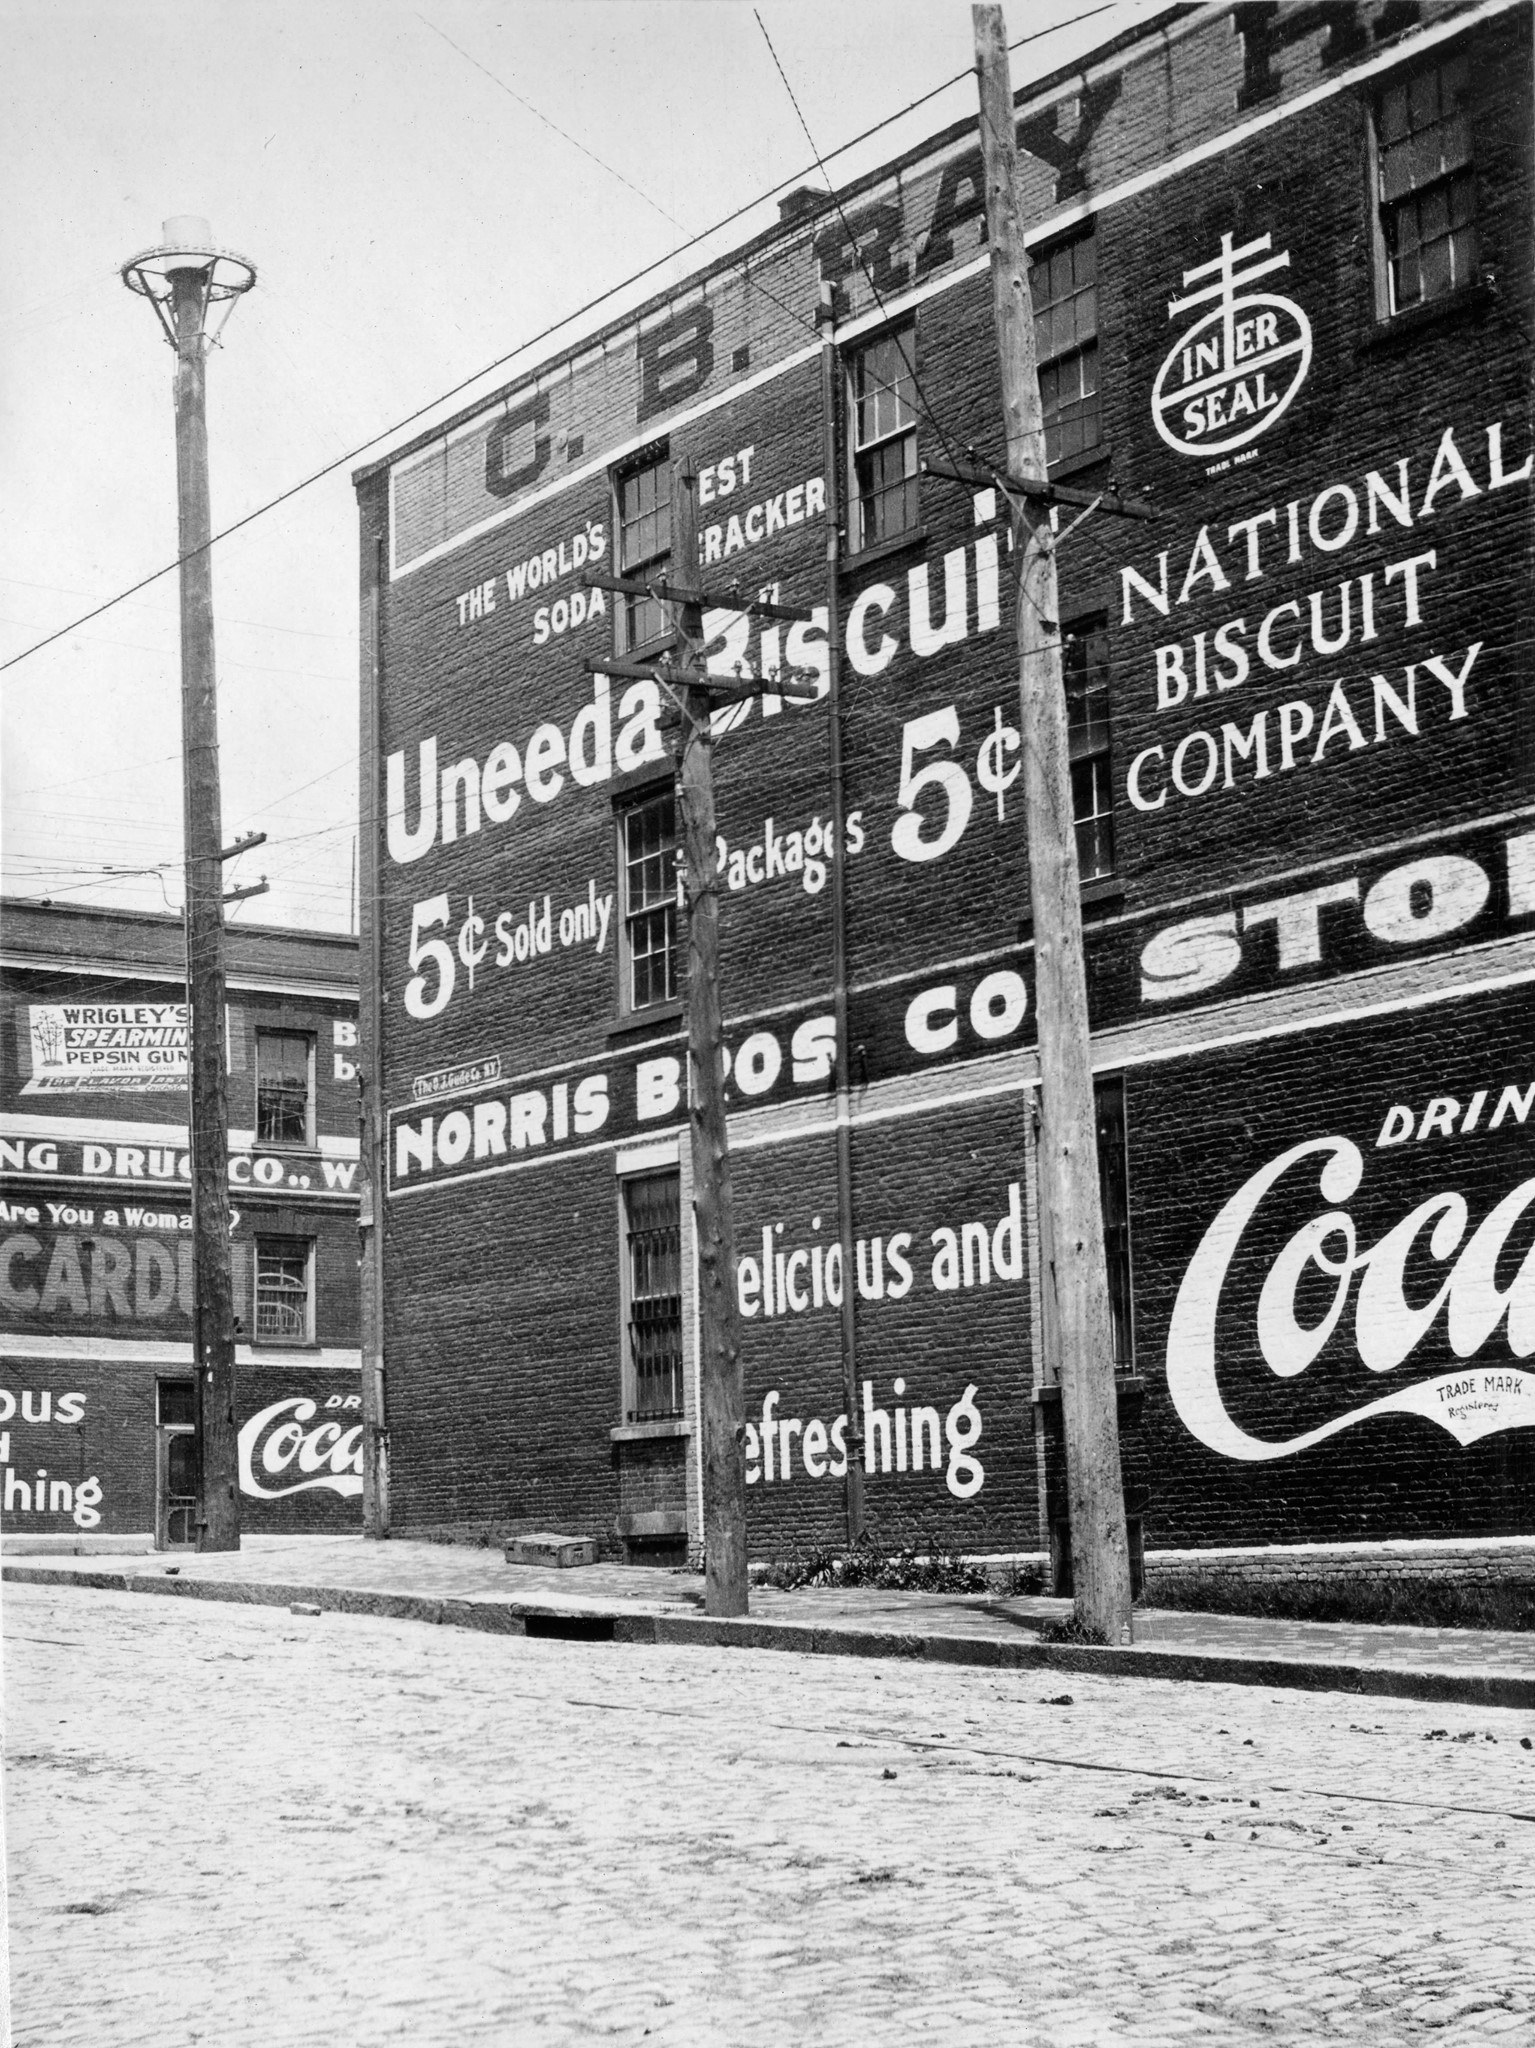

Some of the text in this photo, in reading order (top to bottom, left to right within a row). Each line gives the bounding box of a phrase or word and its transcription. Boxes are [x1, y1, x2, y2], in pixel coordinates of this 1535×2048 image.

[1183, 373, 1279, 440] SEAL
[456, 446, 755, 636] THE WORLD'S EST
[1119, 422, 1534, 627] NATIONAL
[533, 586, 606, 645] SODA
[1154, 549, 1438, 711] BISCUIT
[386, 487, 1058, 864] Uneeda Biscui
[1127, 641, 1484, 811] COMPANY
[495, 896, 552, 967] Sold
[559, 878, 613, 954] only
[63, 1006, 187, 1025] WRIGLEY'S
[66, 1028, 187, 1047] SPEARMIN
[66, 1051, 140, 1065] PEPSIN
[396, 1073, 610, 1177] NORRIS
[46, 1204, 94, 1224] You
[102, 1210, 119, 1226] a
[736, 1182, 1023, 1317] elicious and
[1436, 1376, 1523, 1402] TRADE MARK
[744, 1377, 985, 1499] efreshing
[4, 1467, 104, 1529] hing
